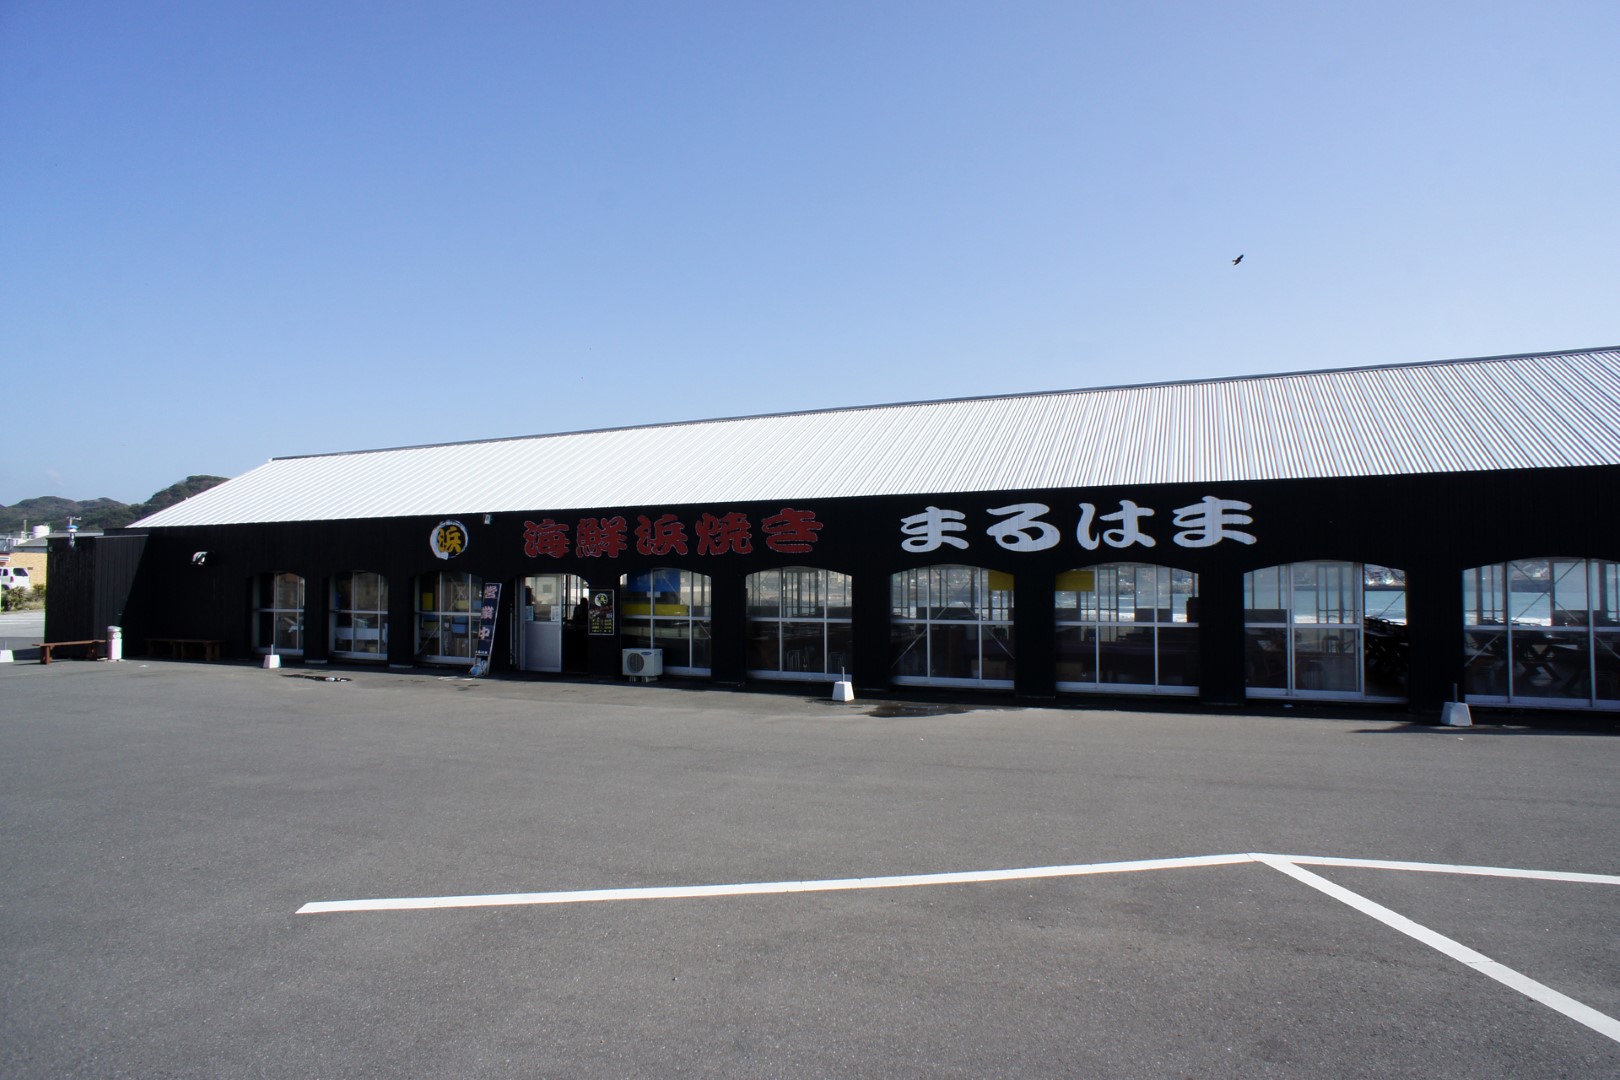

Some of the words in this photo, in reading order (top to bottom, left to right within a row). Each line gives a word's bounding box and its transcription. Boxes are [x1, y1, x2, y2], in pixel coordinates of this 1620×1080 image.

[437, 526, 462, 553] 浜
[523, 508, 824, 558] 海鮮浜焼き
[900, 495, 1258, 553] まるはま
[478, 585, 498, 640] 営業中
